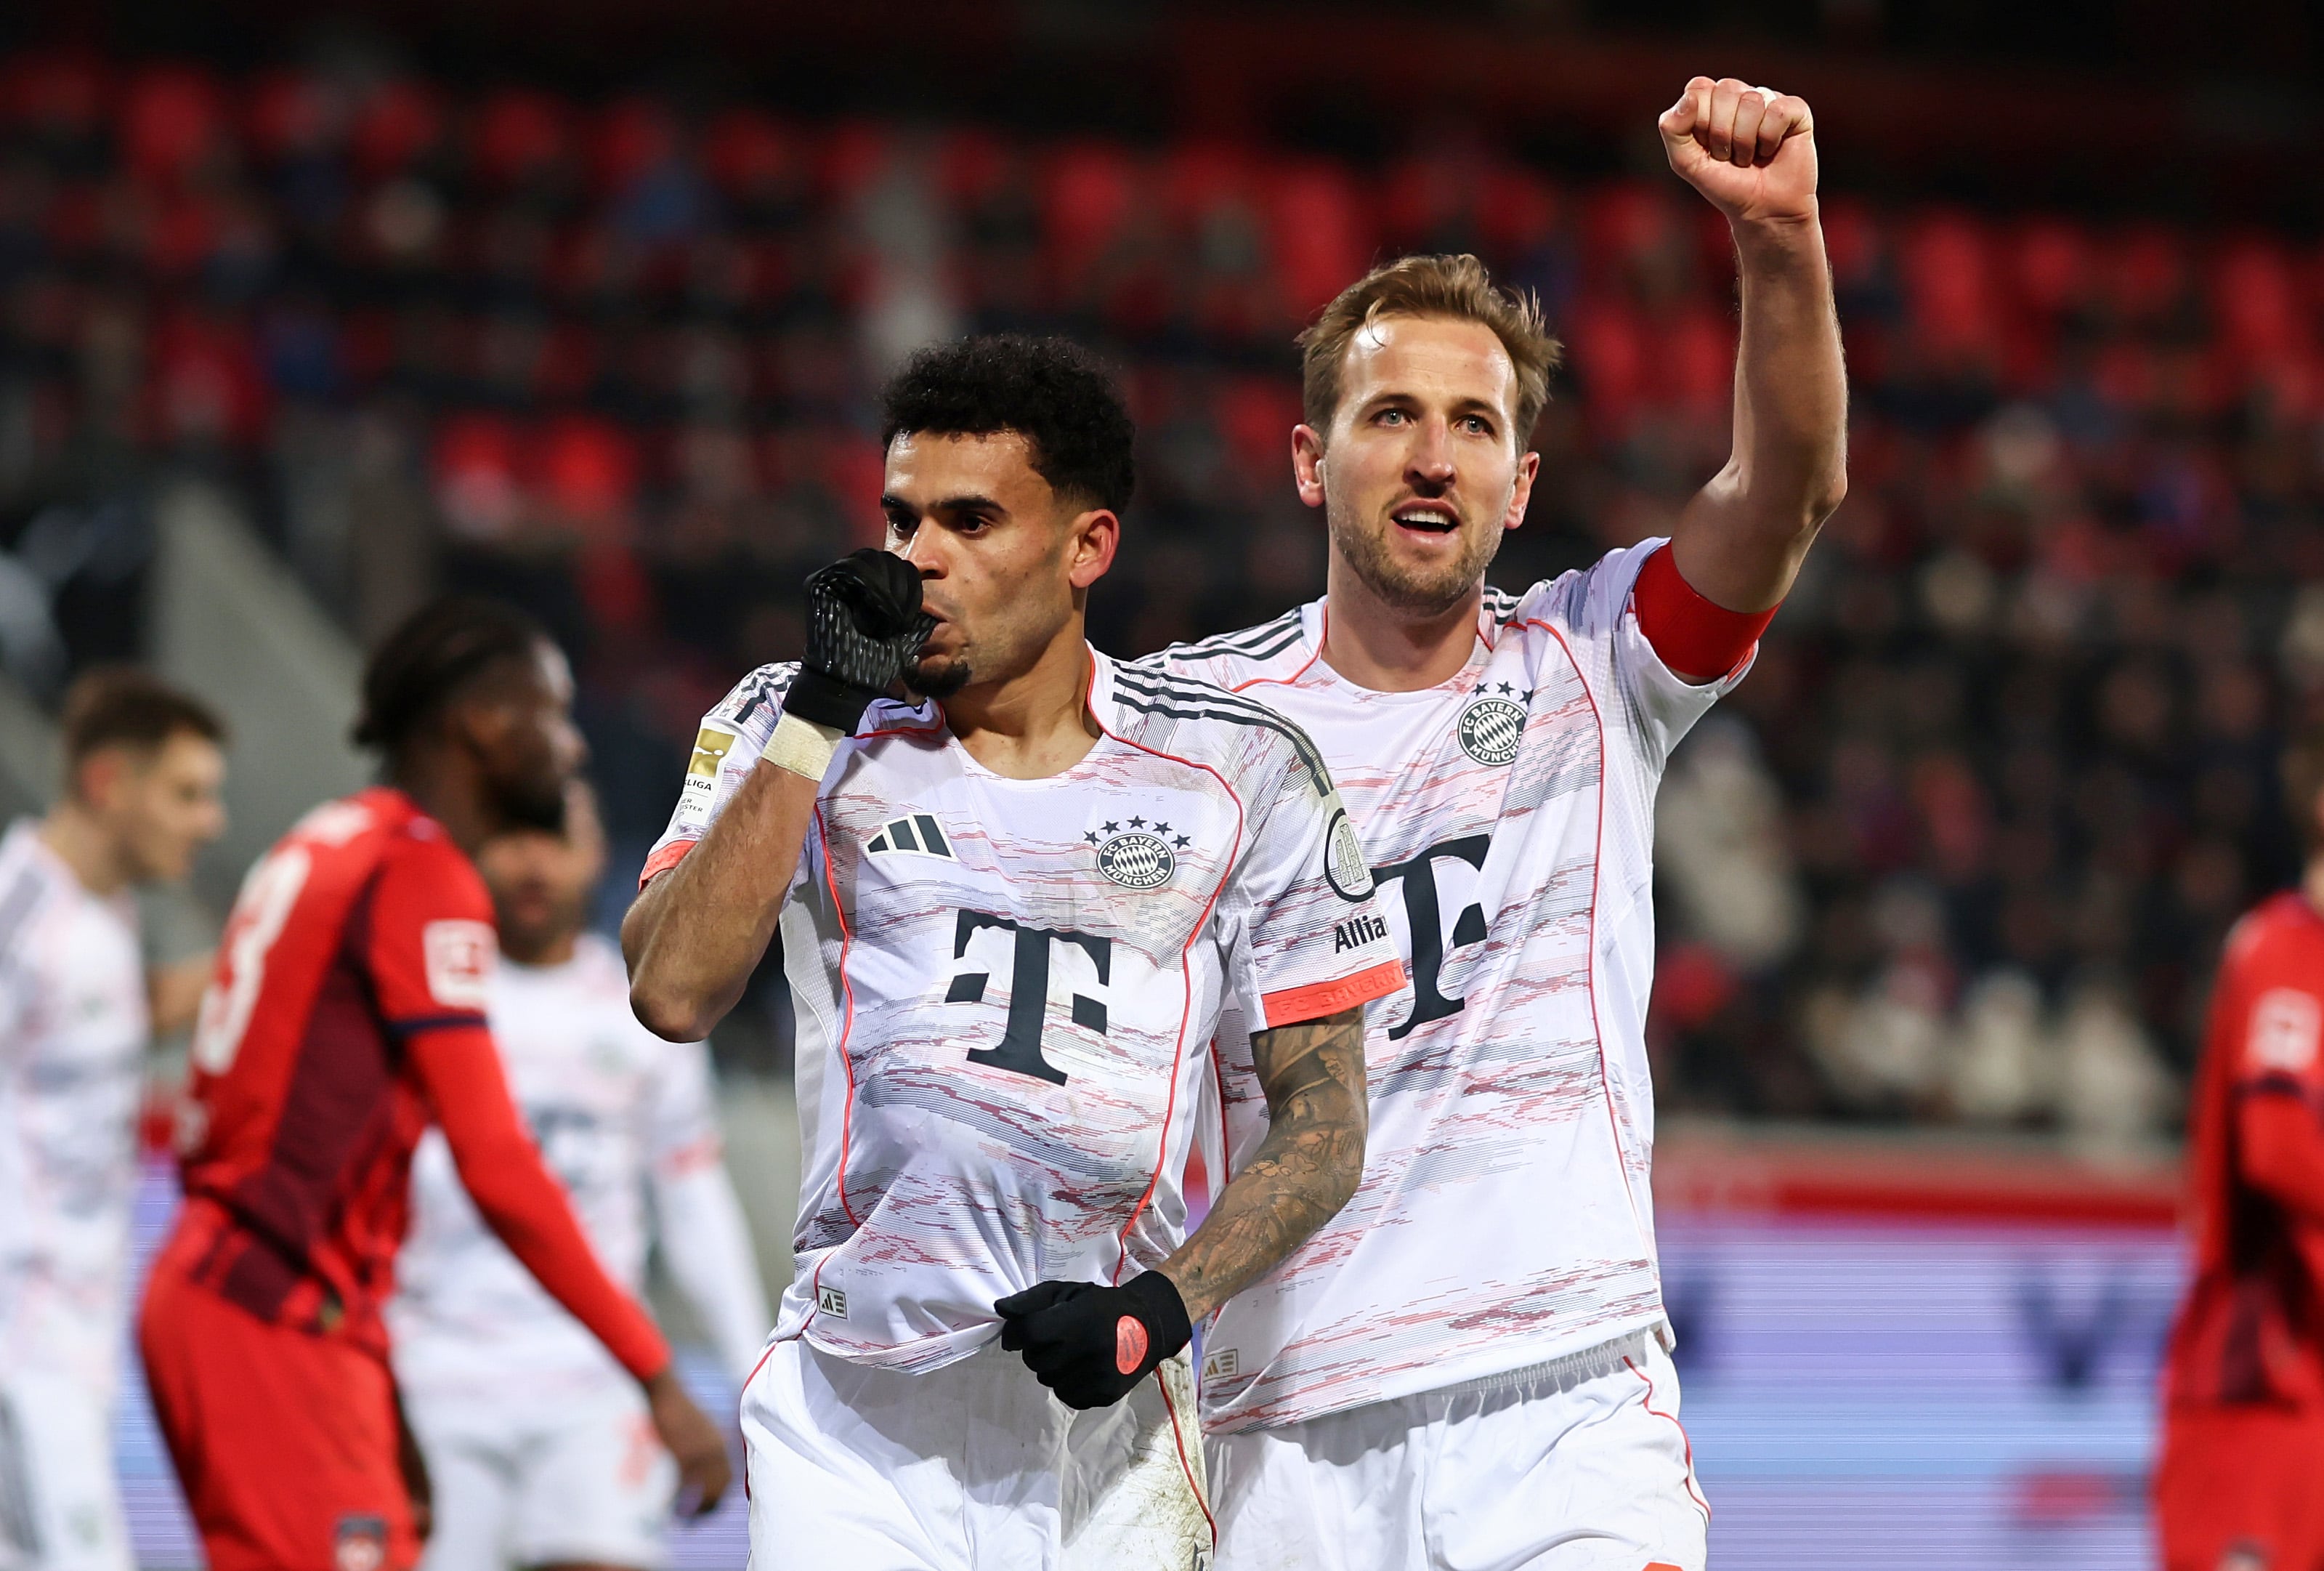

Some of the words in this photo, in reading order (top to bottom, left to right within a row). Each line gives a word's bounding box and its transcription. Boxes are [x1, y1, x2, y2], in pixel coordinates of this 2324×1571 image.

[1463, 717, 1474, 733] FC
[1471, 703, 1523, 722] BAYERN
[1103, 844, 1119, 857] FC
[1119, 836, 1168, 859] BAYERN
[1104, 863, 1168, 886] MÜNCHEN
[944, 909, 1111, 1086] T
